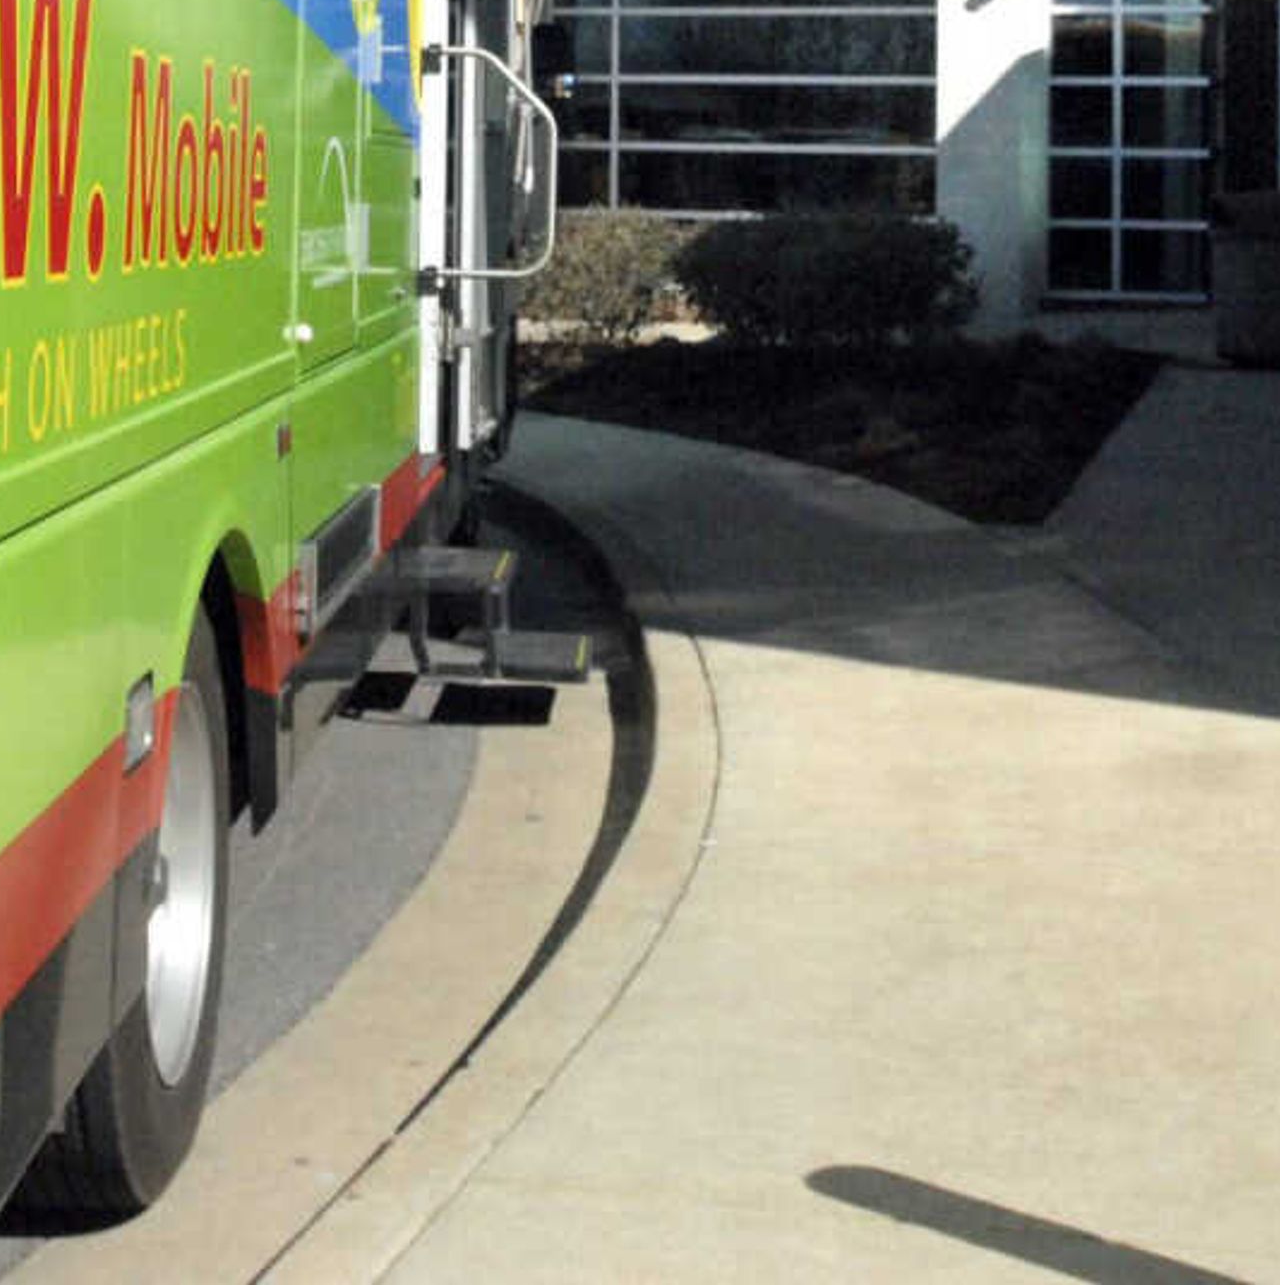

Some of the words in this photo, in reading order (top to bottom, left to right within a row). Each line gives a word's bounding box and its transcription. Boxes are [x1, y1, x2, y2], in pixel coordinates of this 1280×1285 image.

[122, 47, 270, 272] Mobile
[27, 341, 77, 445] ON
[87, 308, 188, 419] WHEELS
